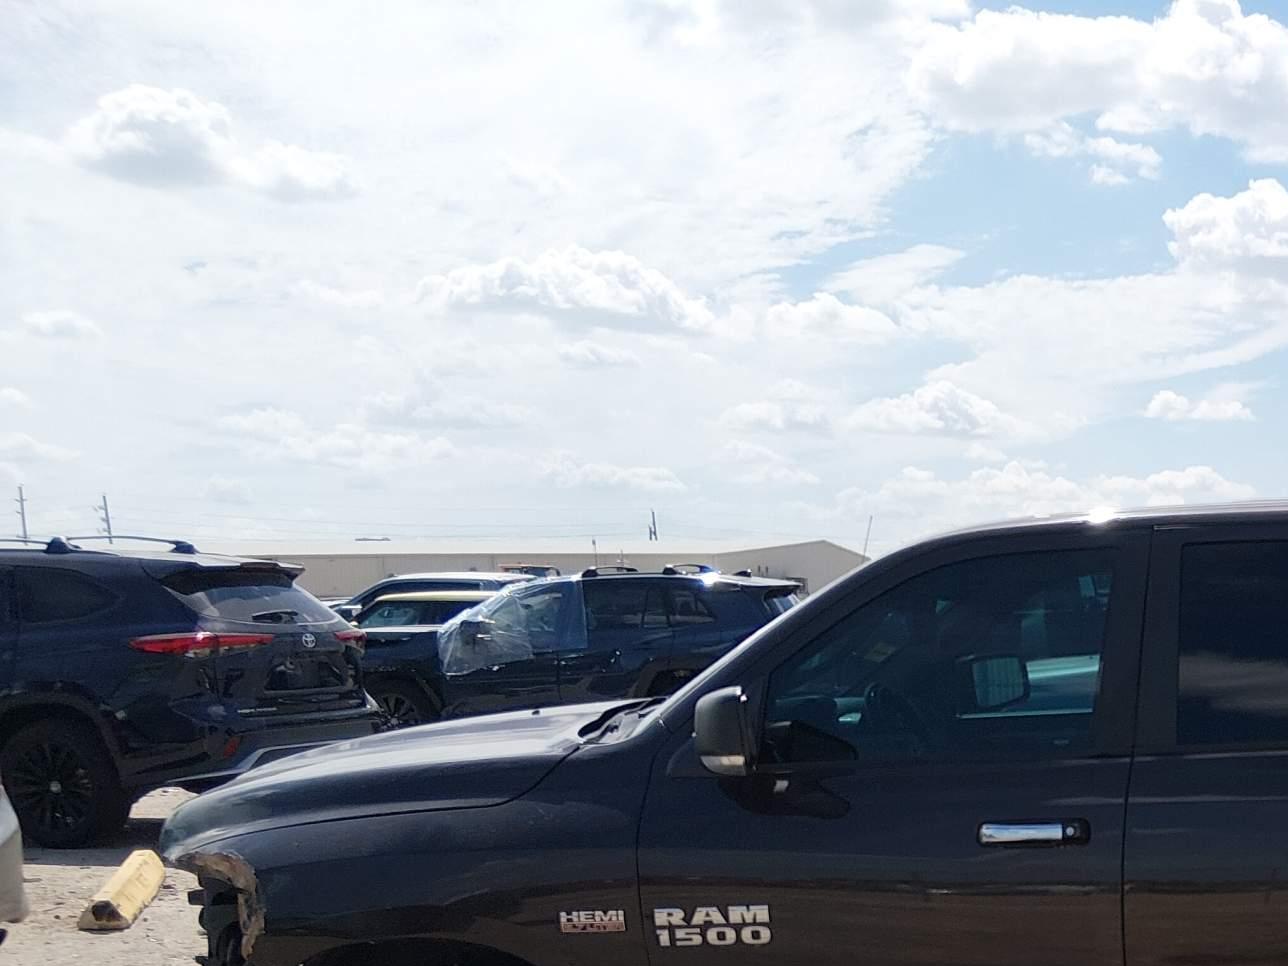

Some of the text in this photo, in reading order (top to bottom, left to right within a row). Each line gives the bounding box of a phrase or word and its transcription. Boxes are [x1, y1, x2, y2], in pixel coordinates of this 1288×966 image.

[559, 910, 625, 922] HEMI
[653, 905, 770, 926] RAM
[656, 926, 772, 947] 1500
